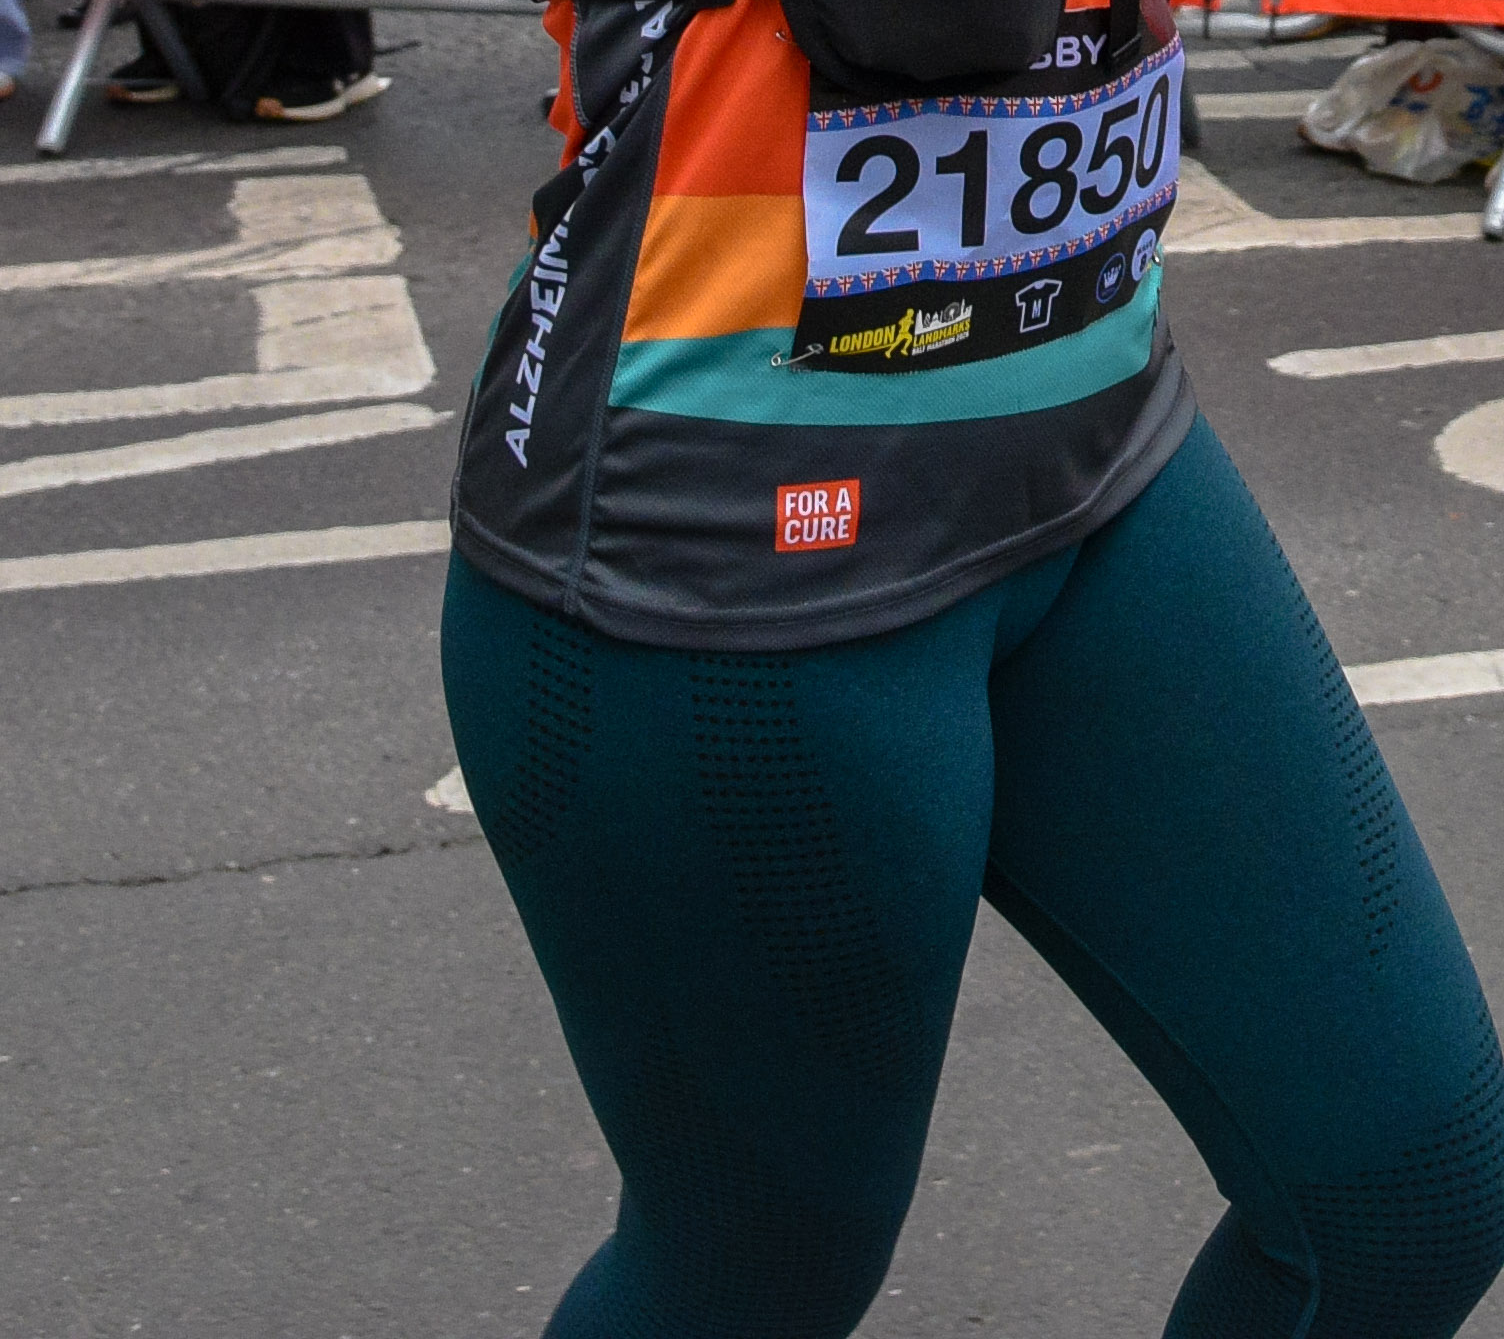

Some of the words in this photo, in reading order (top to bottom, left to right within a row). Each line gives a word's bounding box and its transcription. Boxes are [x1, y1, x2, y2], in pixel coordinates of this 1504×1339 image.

[835, 73, 1170, 258] 21850
[1031, 297, 1043, 320] M
[829, 324, 897, 354] LONDON
[913, 317, 971, 348] LANDMARKS
[784, 489, 829, 518] FOR
[835, 486, 852, 513] A
[784, 513, 852, 545] CURE
